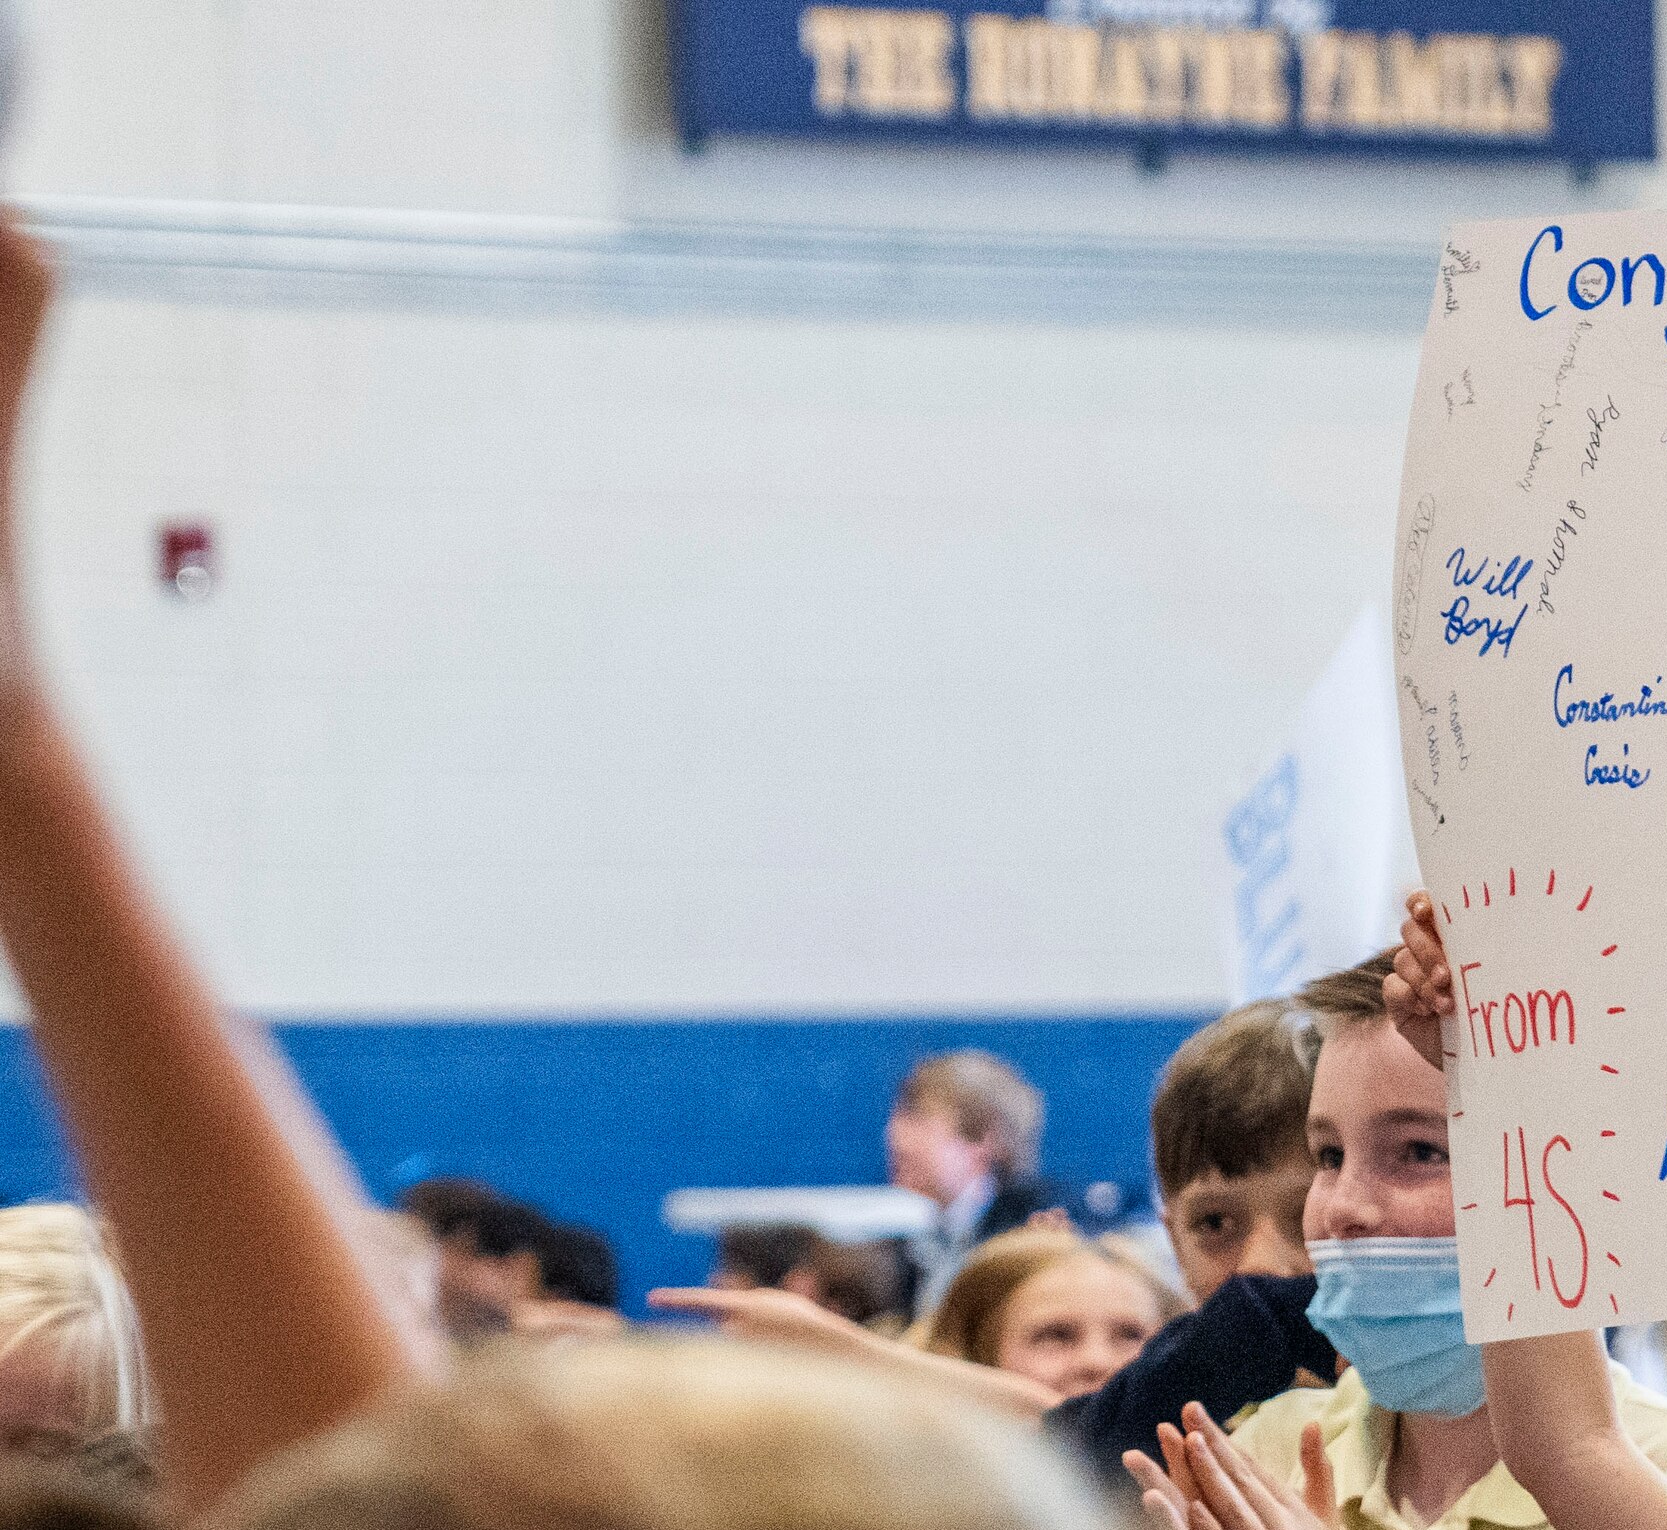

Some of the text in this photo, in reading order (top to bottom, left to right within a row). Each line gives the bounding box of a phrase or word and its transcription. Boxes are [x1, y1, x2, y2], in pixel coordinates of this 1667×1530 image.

[1299, 28, 1563, 140] FAMILY
[1446, 546, 1533, 600] Will
[1461, 962, 1576, 1058] From
